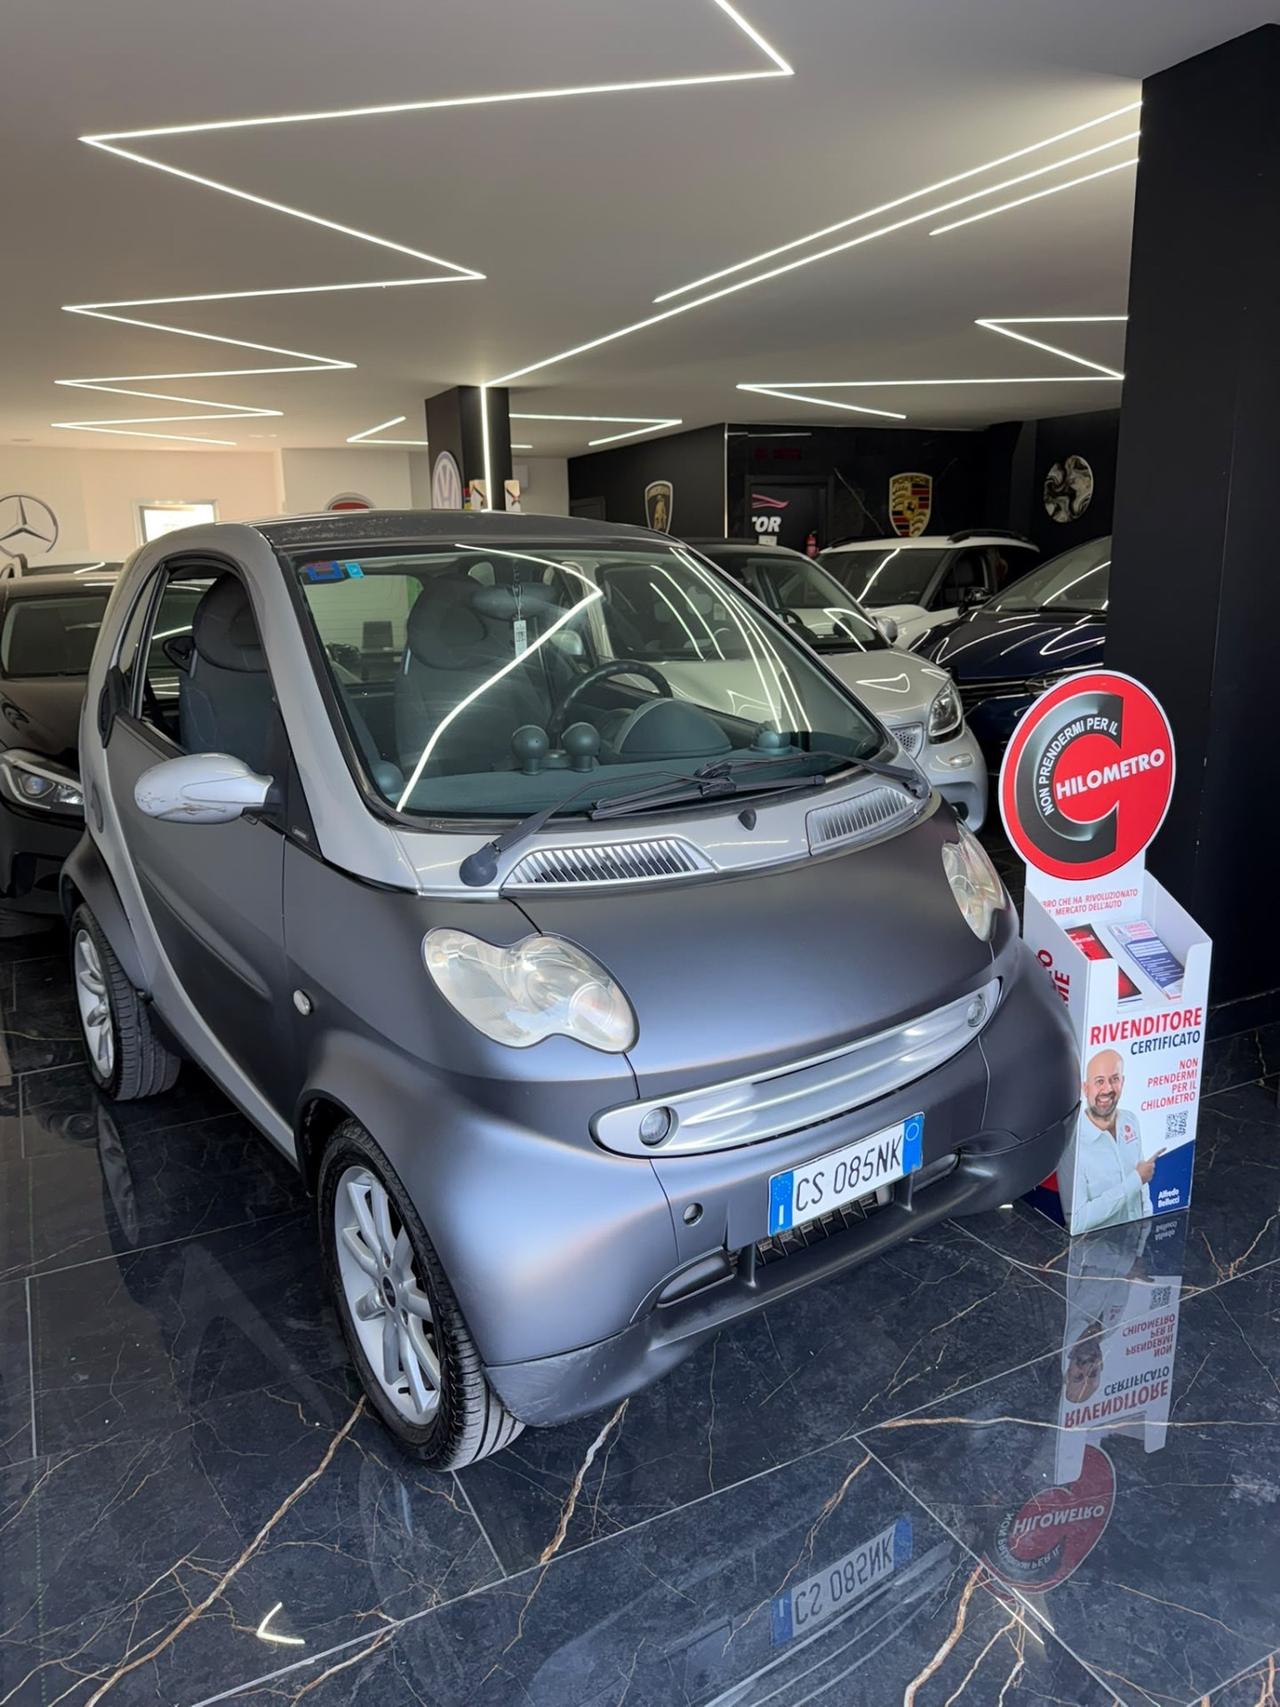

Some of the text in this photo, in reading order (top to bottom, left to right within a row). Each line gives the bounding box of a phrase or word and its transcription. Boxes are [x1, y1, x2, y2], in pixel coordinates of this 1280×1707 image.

[752, 516, 782, 533] OR
[1038, 717, 1118, 816] NON PRENDERMI PER IL
[1055, 748, 1166, 800] HILOMETRO
[1059, 897, 1071, 907] CHE
[1072, 896, 1083, 905] HA
[1085, 888, 1138, 902] RIVOLUZIONATO
[1055, 904, 1087, 916] MERCATO
[1088, 900, 1122, 912] DELL'AUTO
[1089, 1007, 1203, 1046] RIVENDITORE
[1130, 1030, 1201, 1056] CERTIFICATO
[1179, 1058, 1199, 1070] NON
[1147, 1069, 1198, 1087] PRENDERMI
[1171, 1081, 1197, 1094] PER IL
[1140, 1092, 1196, 1111] CHILOMETRO
[796, 1172, 825, 1211] CS
[833, 1134, 903, 1195] 085NK
